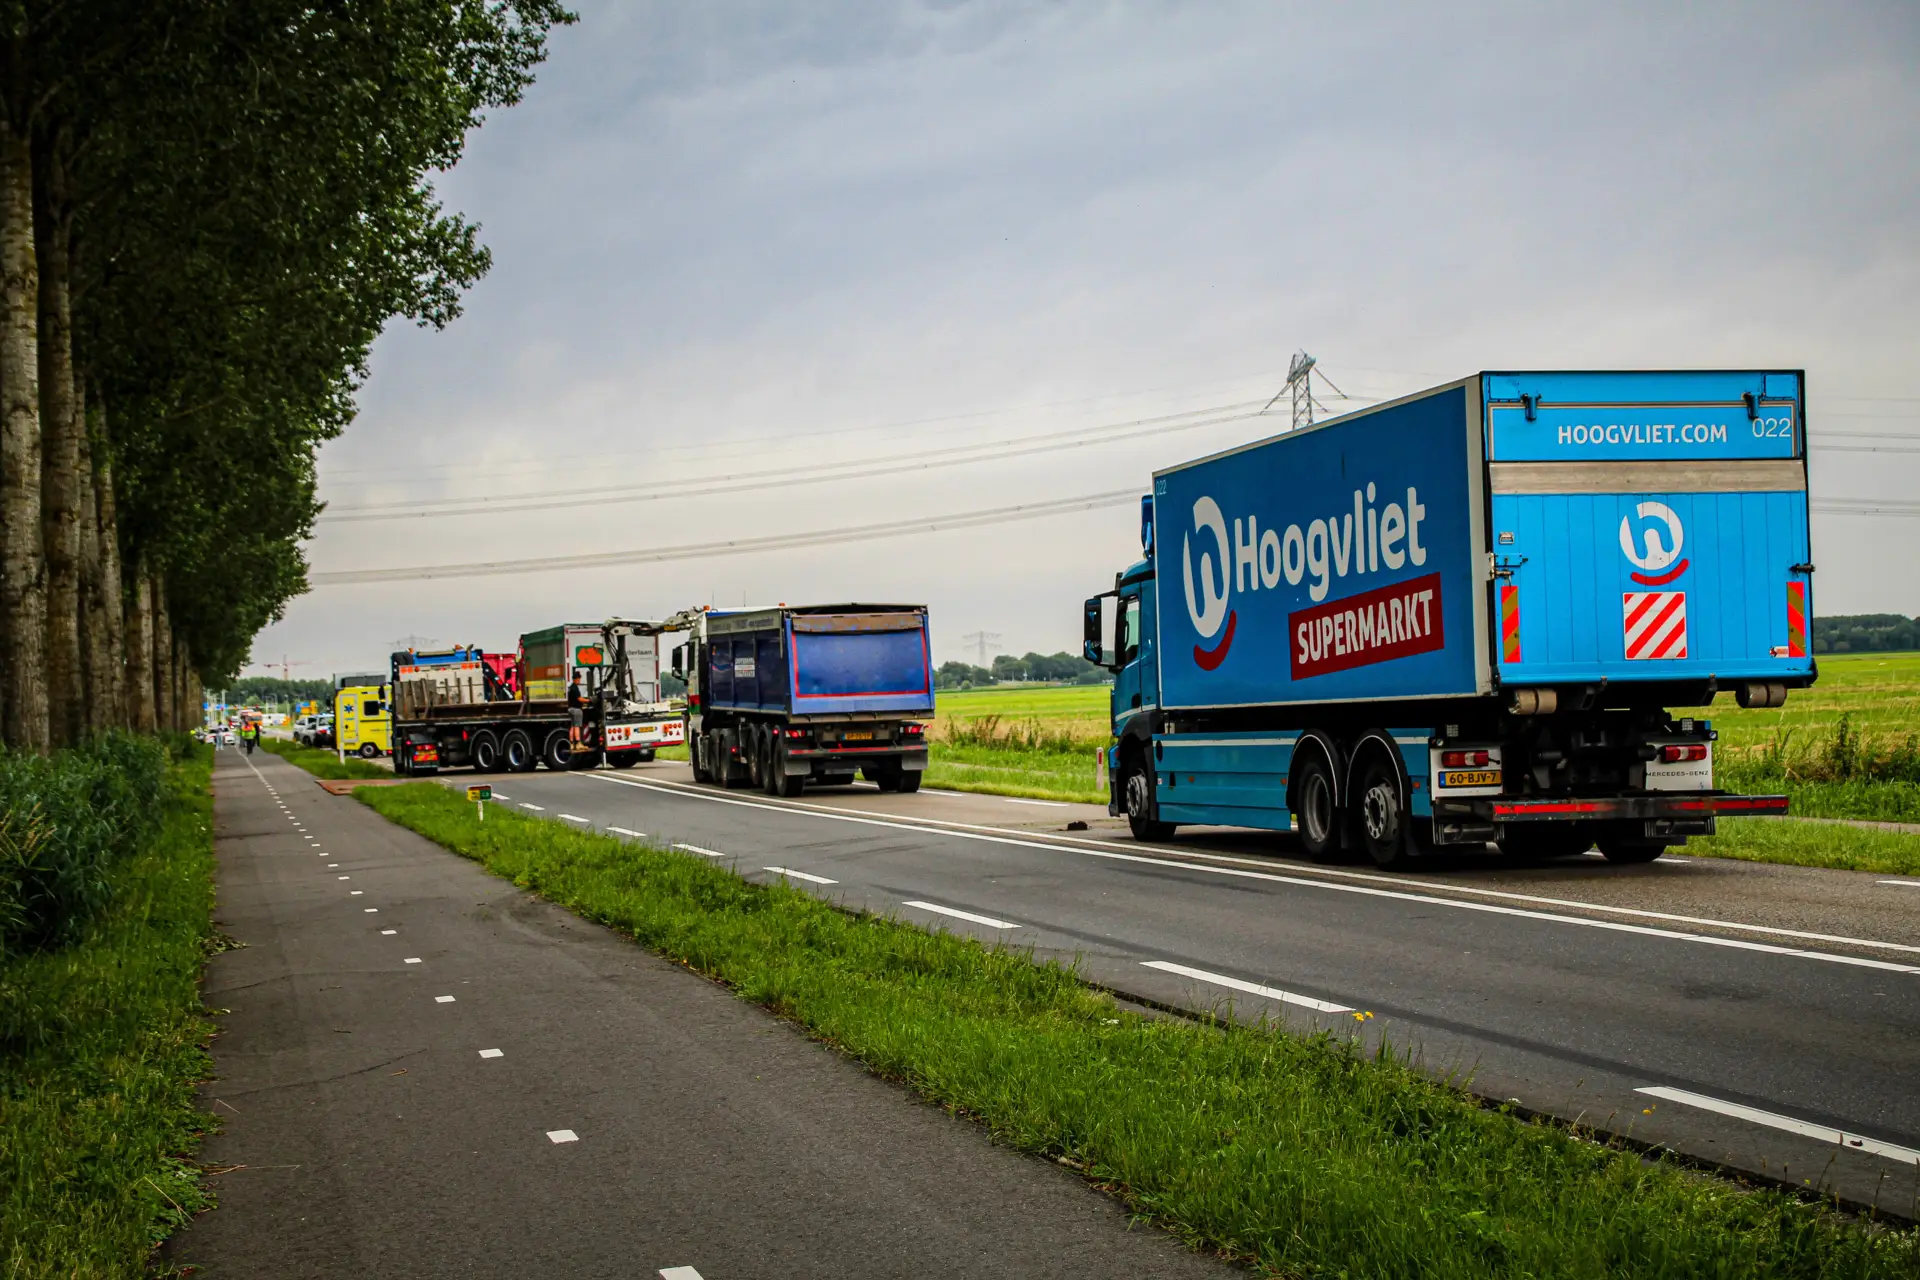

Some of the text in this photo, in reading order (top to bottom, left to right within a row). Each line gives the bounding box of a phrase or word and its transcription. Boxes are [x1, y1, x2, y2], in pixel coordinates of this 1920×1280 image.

[1558, 424, 1728, 444] HOOGVLIET.COM
[1752, 417, 1792, 438] 022
[1234, 481, 1427, 602] Hoogvliet
[1297, 589, 1434, 665] SUPERMARKT
[1449, 772, 1497, 784] 60-BJV-7
